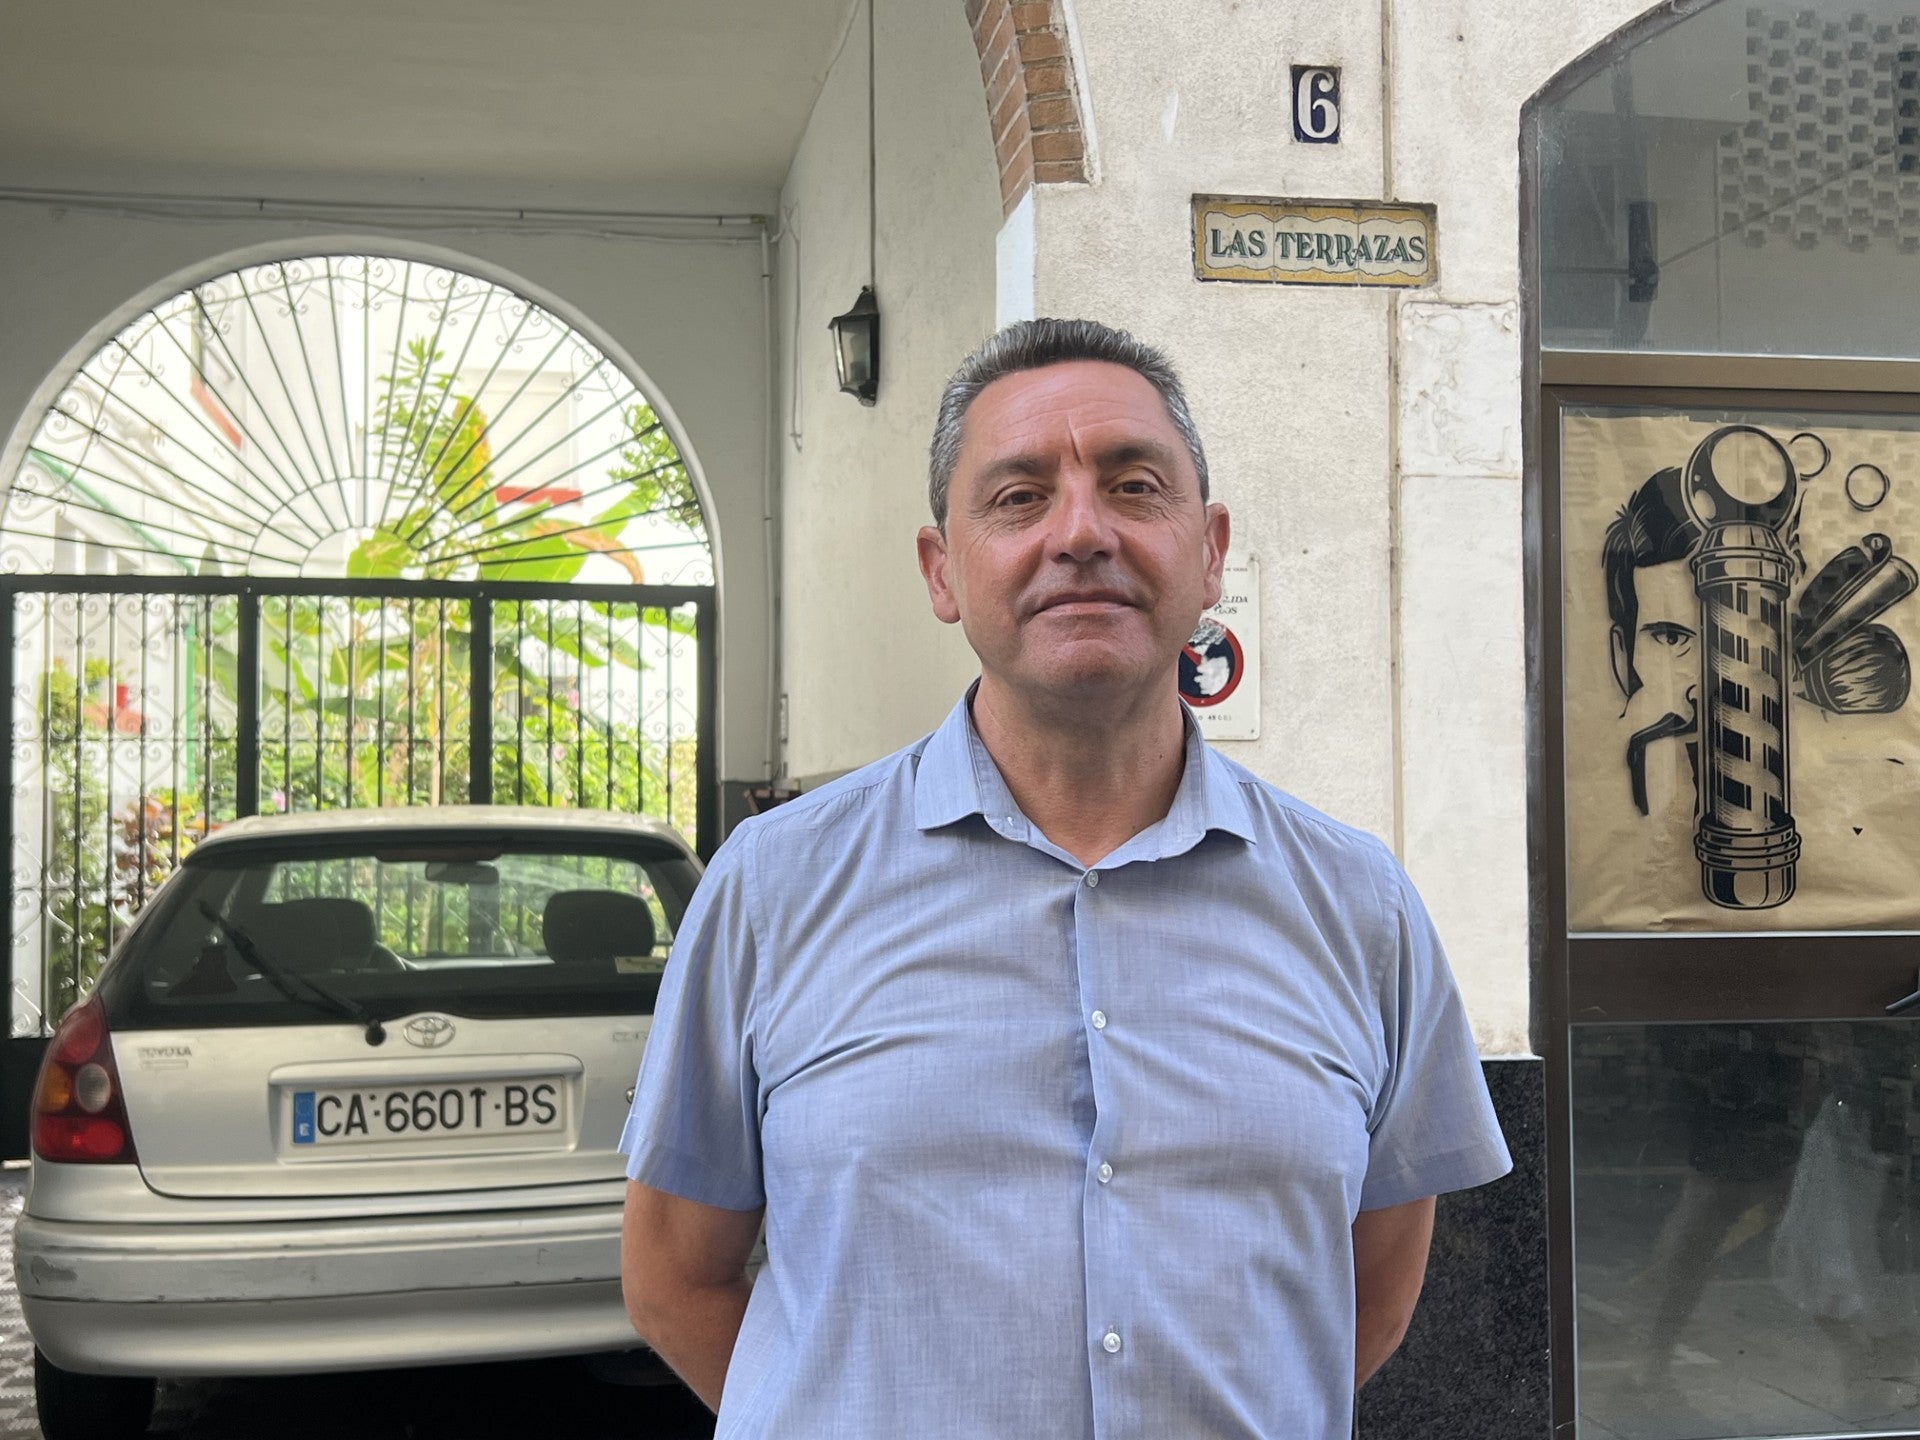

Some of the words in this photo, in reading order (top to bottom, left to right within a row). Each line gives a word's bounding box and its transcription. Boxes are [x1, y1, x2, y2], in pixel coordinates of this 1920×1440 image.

[1298, 68, 1338, 139] 6
[1211, 229, 1266, 257] LAS
[1276, 231, 1427, 266] TERRAZAS
